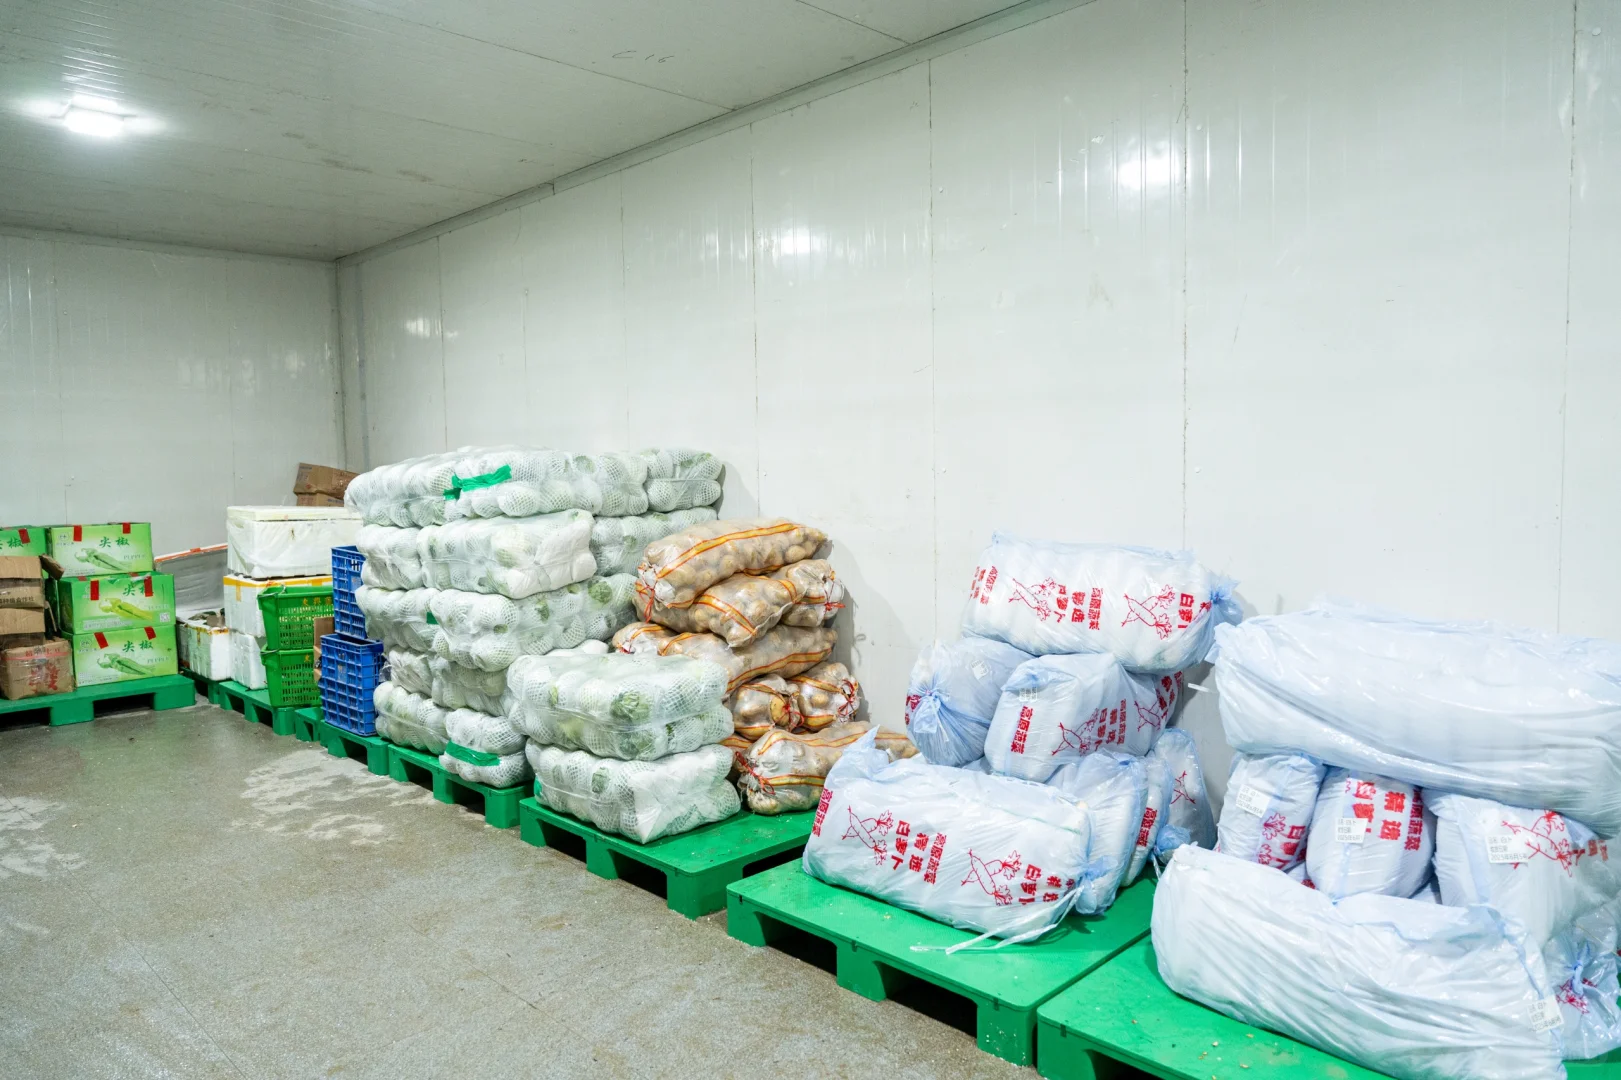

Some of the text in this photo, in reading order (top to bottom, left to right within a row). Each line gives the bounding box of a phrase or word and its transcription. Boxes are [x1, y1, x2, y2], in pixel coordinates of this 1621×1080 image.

[0, 536, 28, 550] 椒
[99, 536, 130, 548] 尖椒
[1053, 584, 1069, 623] 白萝卜
[1071, 591, 1086, 623] 精选
[1088, 587, 1104, 631] 高原蔬菜
[122, 640, 153, 653] 尖椒
[1010, 705, 1034, 754] 高原蔬菜
[812, 788, 834, 837] 高原蔬菜
[1379, 790, 1407, 840] 精选
[890, 819, 911, 871] 白萝卜
[908, 832, 929, 872] 精选
[923, 832, 947, 885] 高原蔬菜
